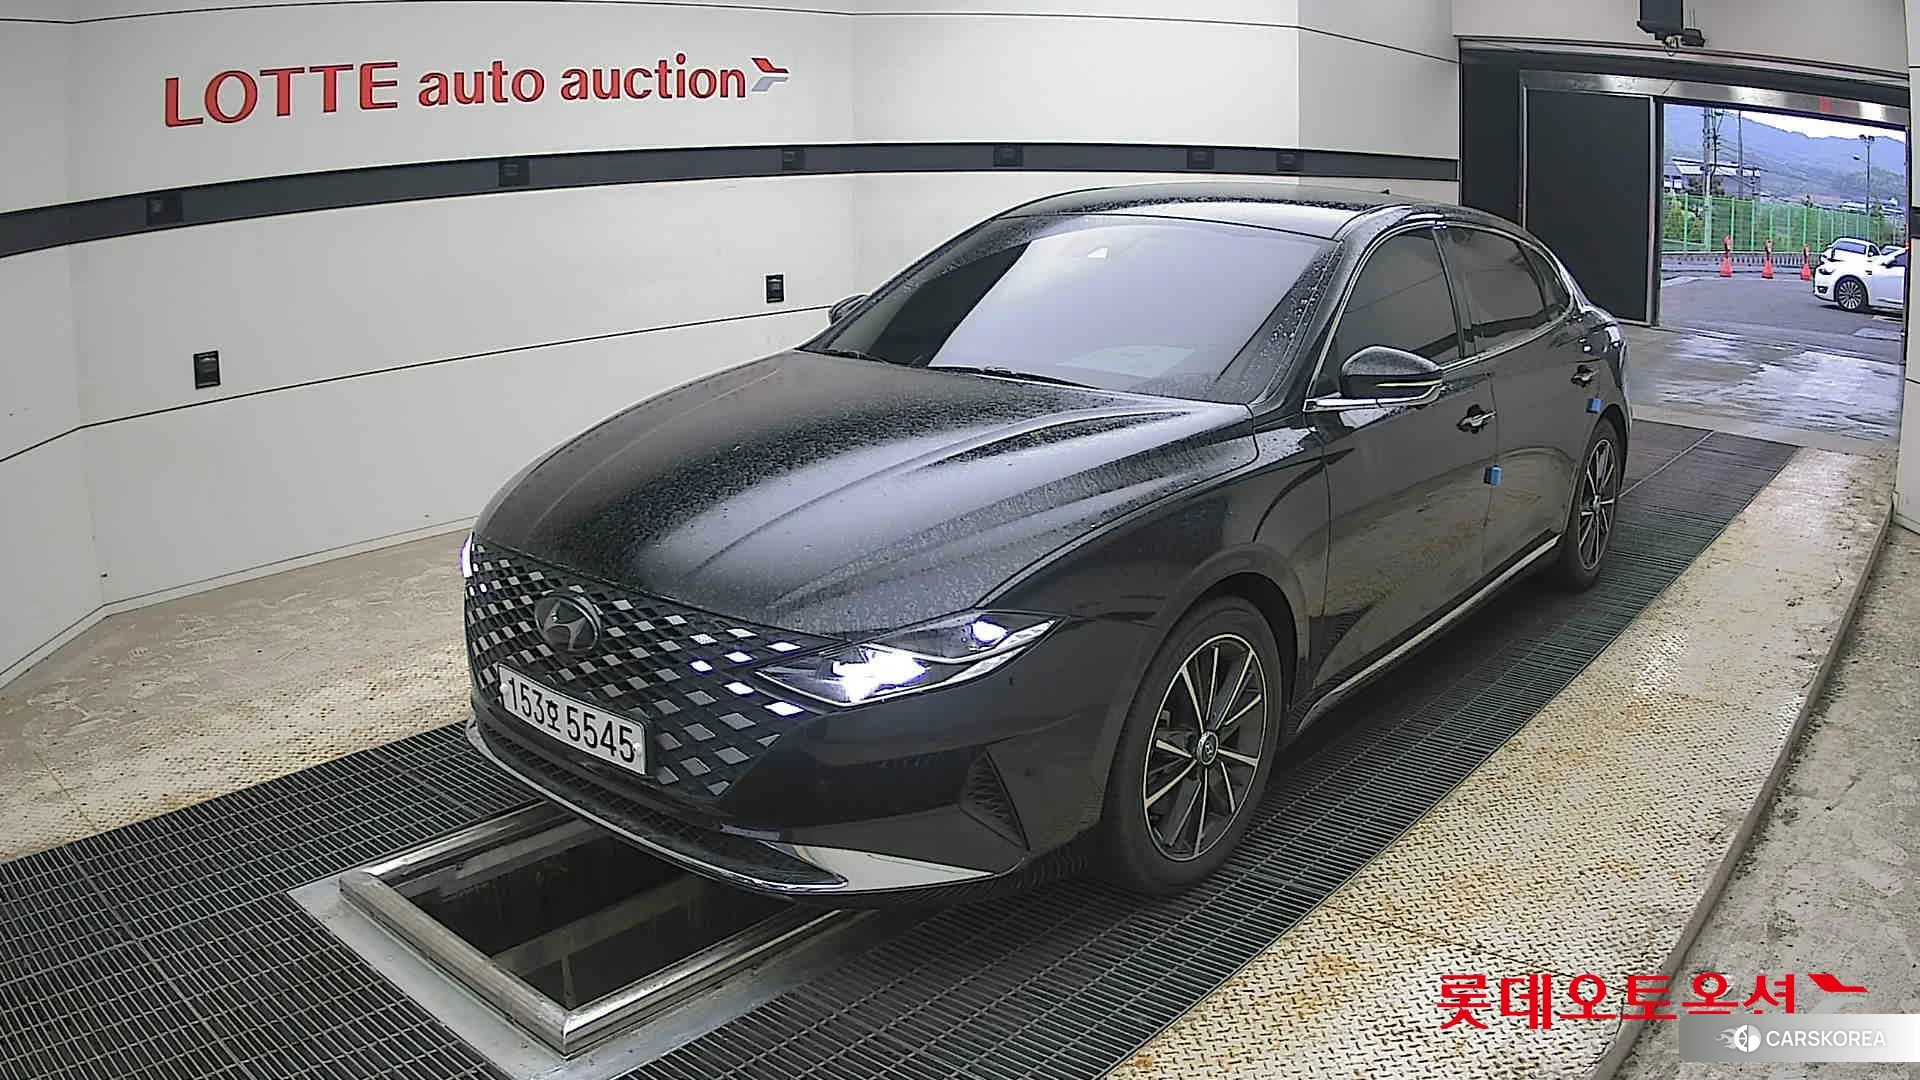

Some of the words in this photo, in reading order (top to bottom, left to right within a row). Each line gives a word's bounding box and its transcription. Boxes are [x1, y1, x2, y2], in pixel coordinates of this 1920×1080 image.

[165, 61, 399, 127] LOTTE
[418, 60, 545, 107] auto
[560, 52, 747, 101] auction
[509, 677, 561, 733] 153호
[566, 704, 636, 763] 5545
